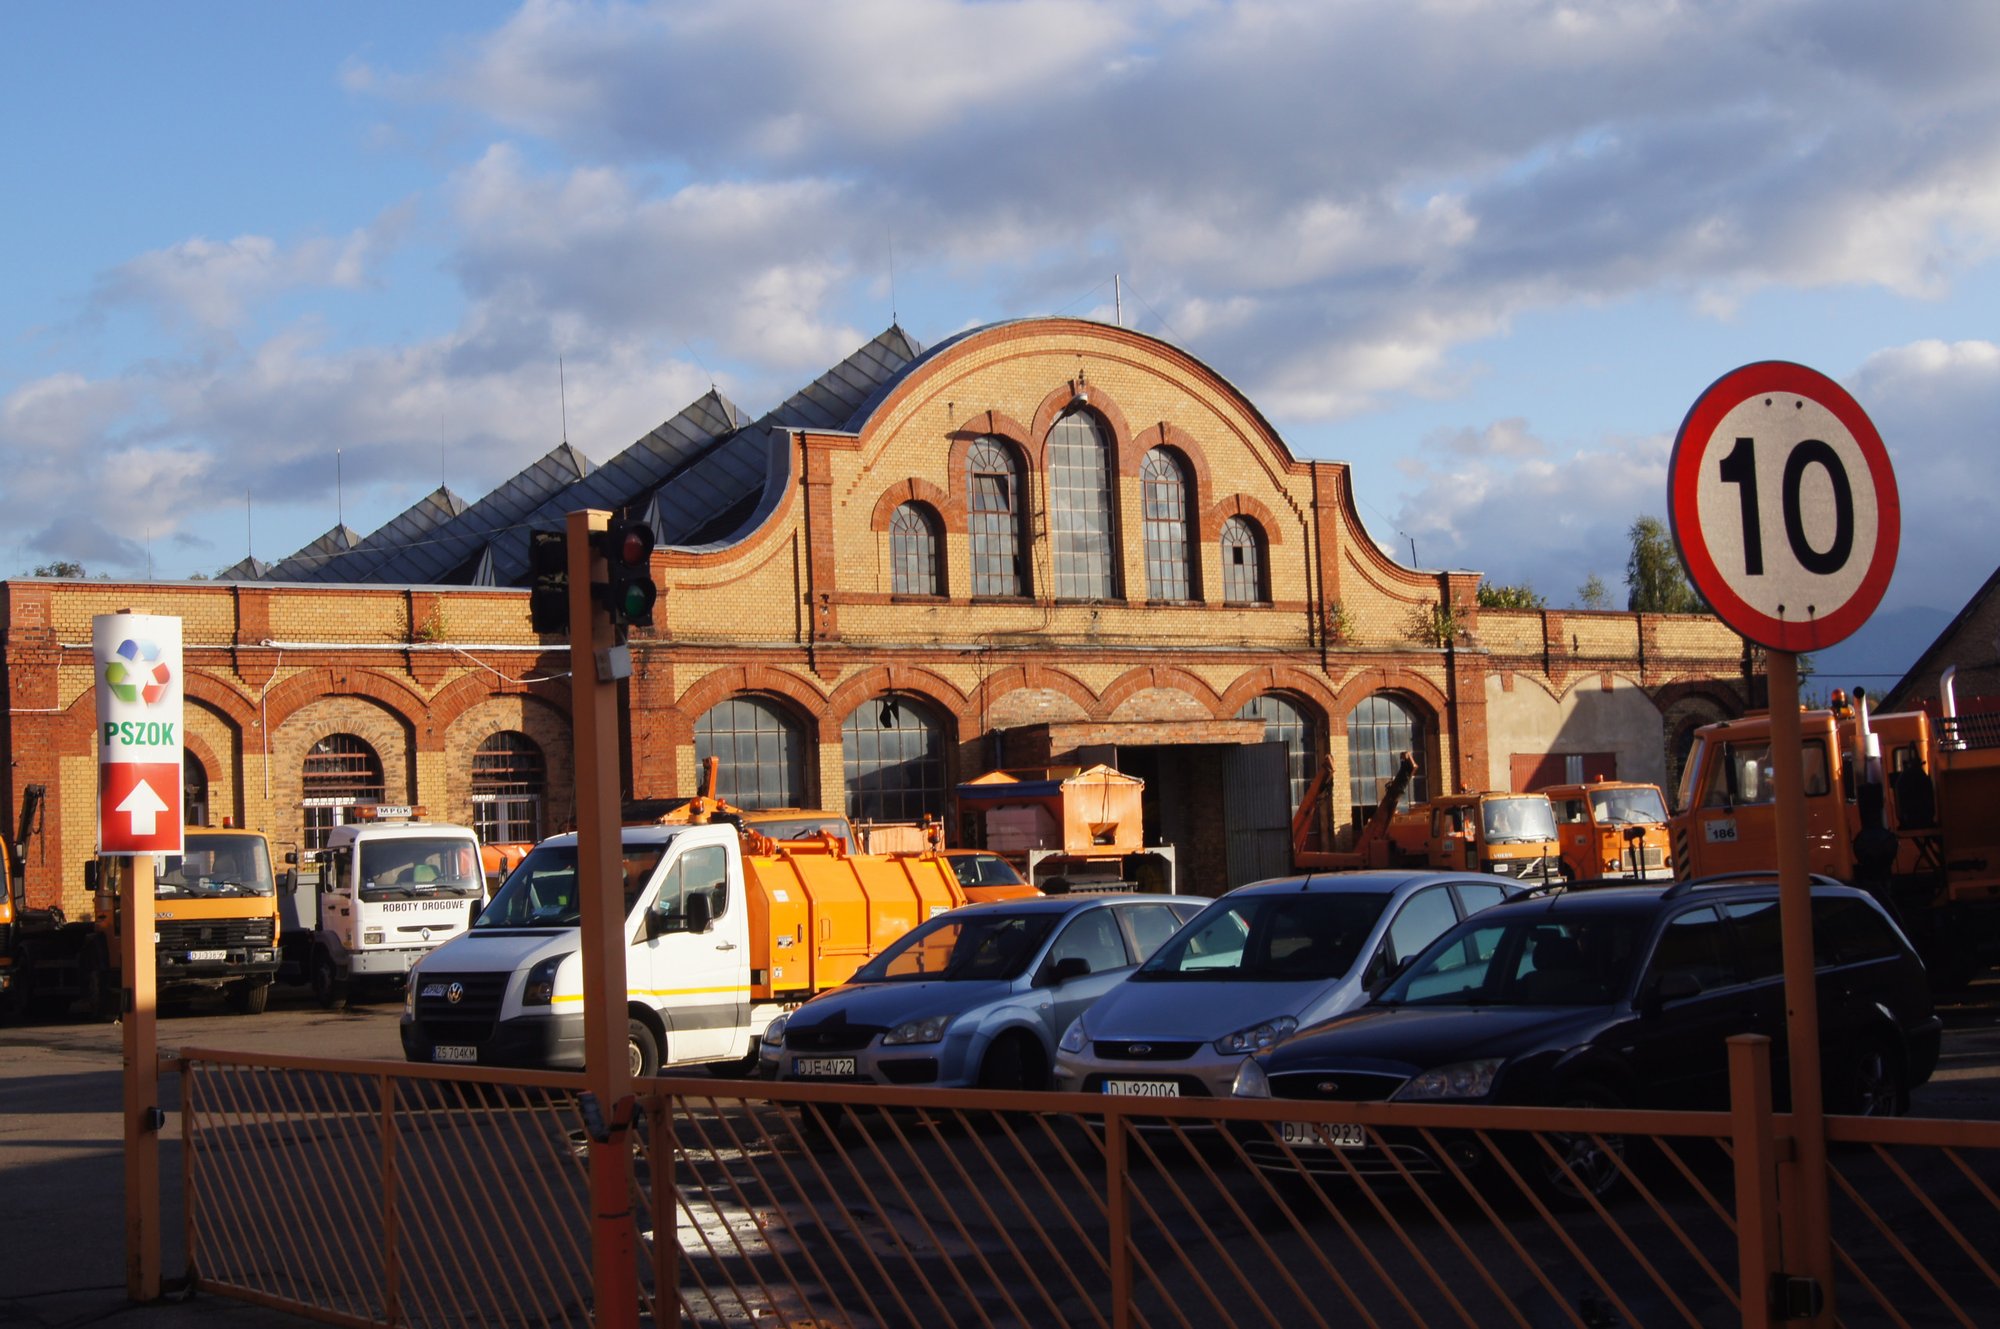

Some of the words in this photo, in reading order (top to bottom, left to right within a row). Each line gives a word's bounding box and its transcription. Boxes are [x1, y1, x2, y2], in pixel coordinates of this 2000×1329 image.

[1719, 437, 1855, 576] 10
[103, 721, 175, 746] PSZOK
[1713, 828, 1735, 839] 186
[382, 902, 419, 912] ROBOTY
[422, 900, 464, 911] DROGOWE
[449, 1047, 476, 1059] 704KM
[800, 1060, 821, 1074] DJE
[825, 1060, 853, 1074] 4V22
[1133, 1083, 1176, 1097] 92006
[1284, 1123, 1304, 1142] DJ
